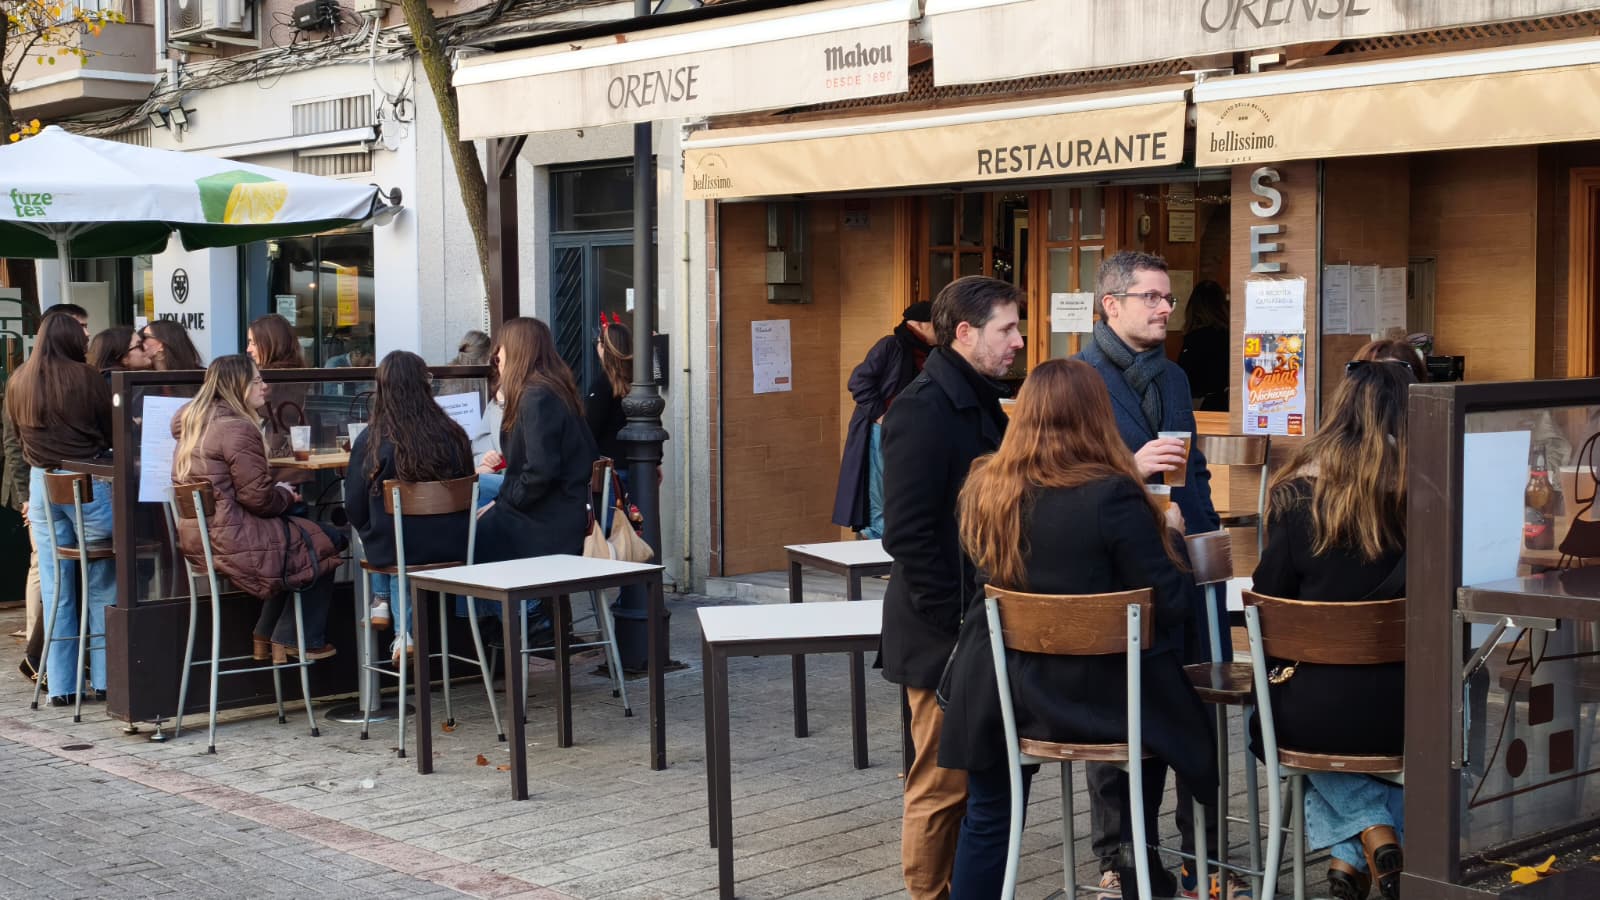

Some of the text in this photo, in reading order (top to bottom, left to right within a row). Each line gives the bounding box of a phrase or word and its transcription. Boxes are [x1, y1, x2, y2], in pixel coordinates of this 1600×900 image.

[824, 42, 892, 71] Mahou
[607, 65, 700, 109] ORENSE
[825, 75, 862, 88] DESDE
[1210, 130, 1274, 153] bellissimo
[977, 131, 1168, 175] RESTAURANTE
[692, 173, 731, 191] bellissimo
[10, 188, 52, 206] fuze
[14, 205, 46, 217] tea
[1245, 337, 1261, 353] 31
[1248, 366, 1298, 391] Cañas
